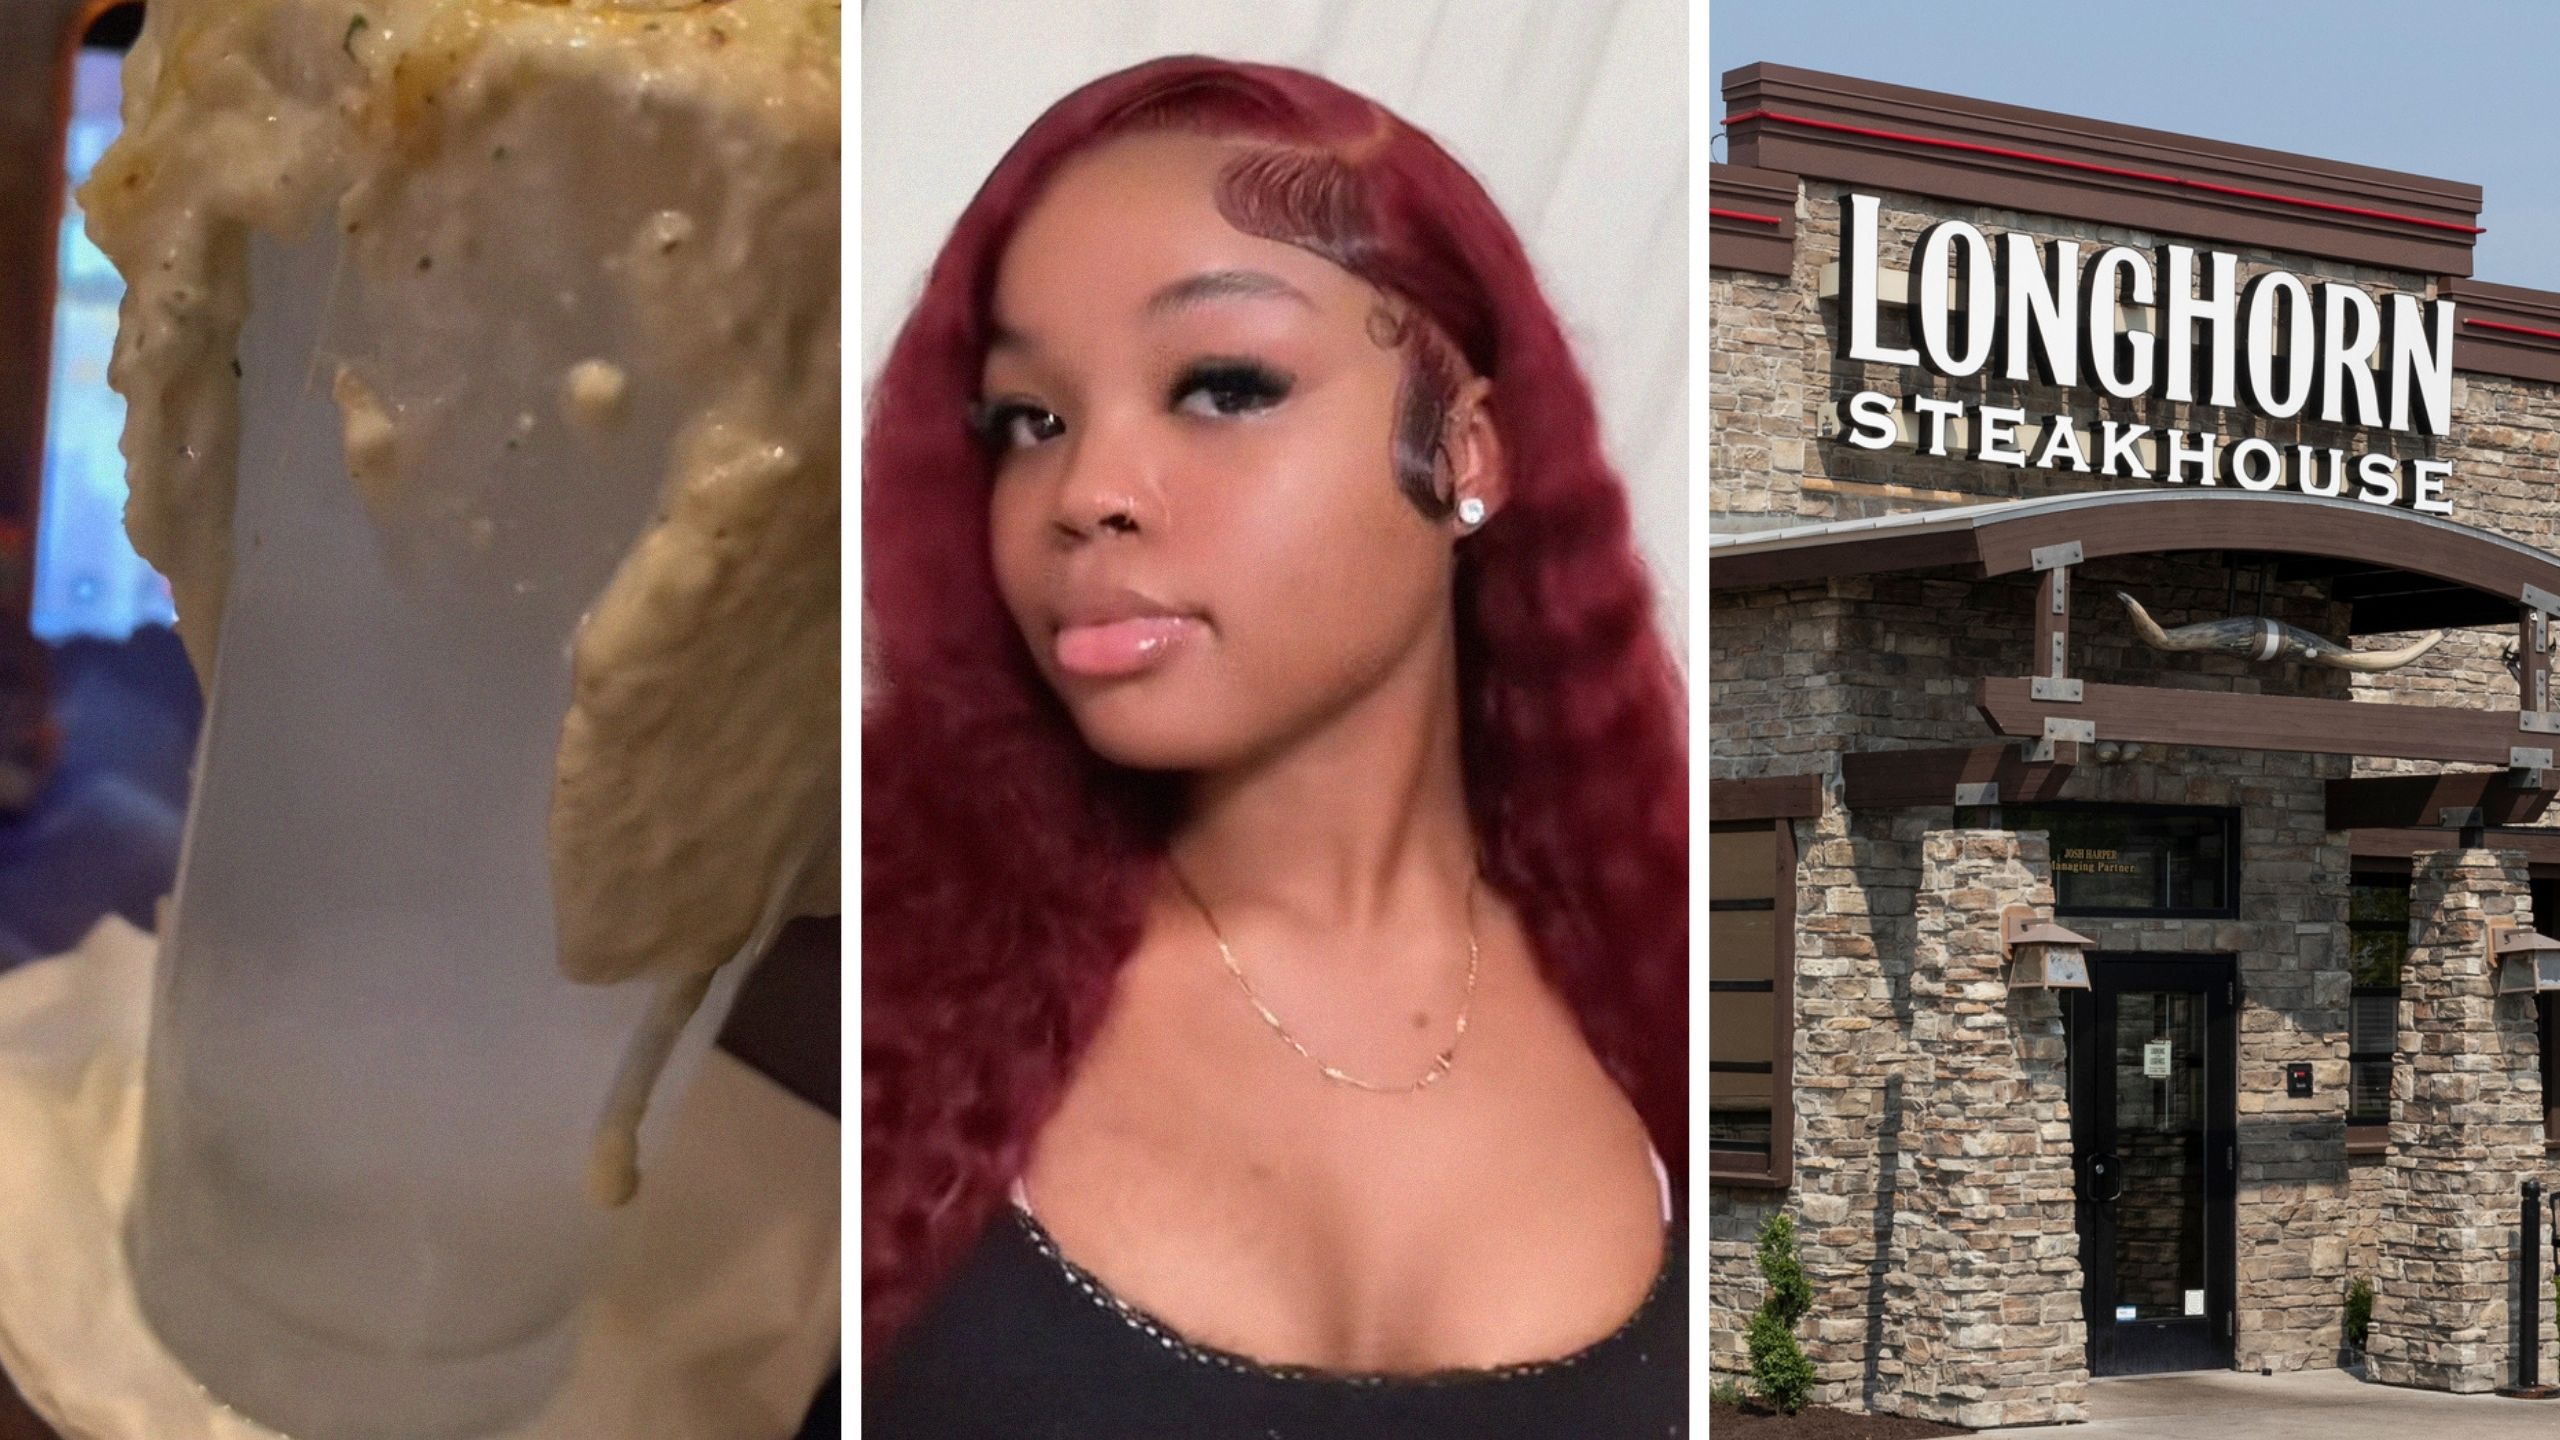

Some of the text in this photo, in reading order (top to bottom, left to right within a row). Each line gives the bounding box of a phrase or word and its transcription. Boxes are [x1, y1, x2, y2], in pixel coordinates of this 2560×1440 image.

[1845, 193, 2456, 436] LONGHORN
[1847, 391, 2454, 515] STEAKHOUSE
[2064, 848, 2118, 860] JOSH HARPER
[2098, 861, 2136, 873] Partner
